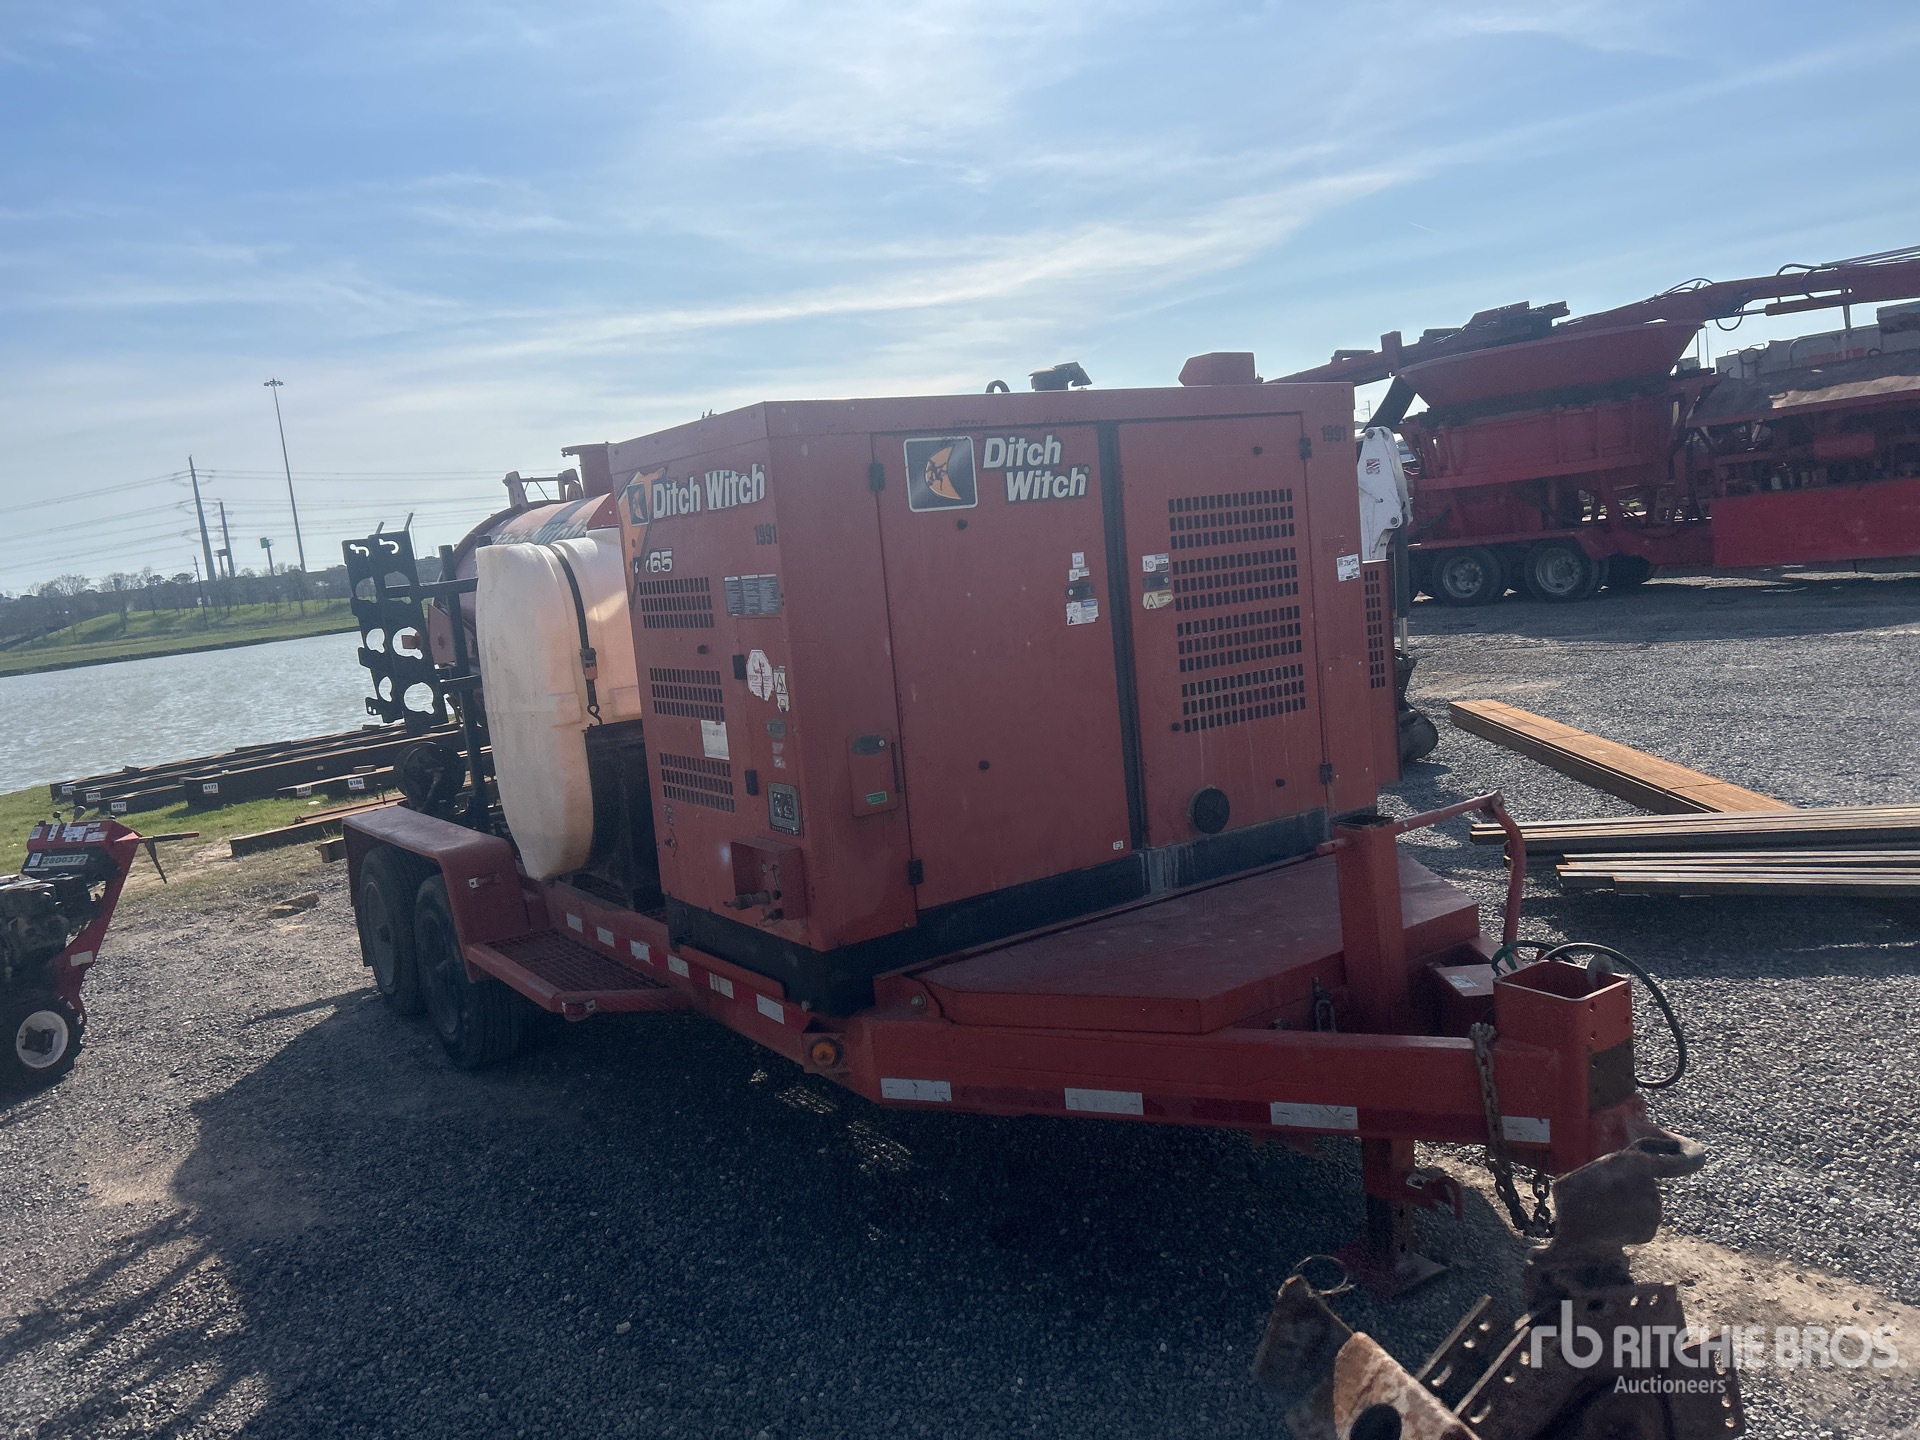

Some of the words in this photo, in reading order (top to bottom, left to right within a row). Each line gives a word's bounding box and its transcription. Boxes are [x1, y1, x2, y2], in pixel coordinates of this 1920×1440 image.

[1321, 424, 1347, 442] 1991
[983, 434, 1062, 469] Ditch
[652, 476, 702, 519] Ditch
[705, 463, 766, 511] Witch
[1006, 467, 1087, 502] Witch
[753, 522, 778, 546] 1991
[43, 856, 86, 865] 2800372
